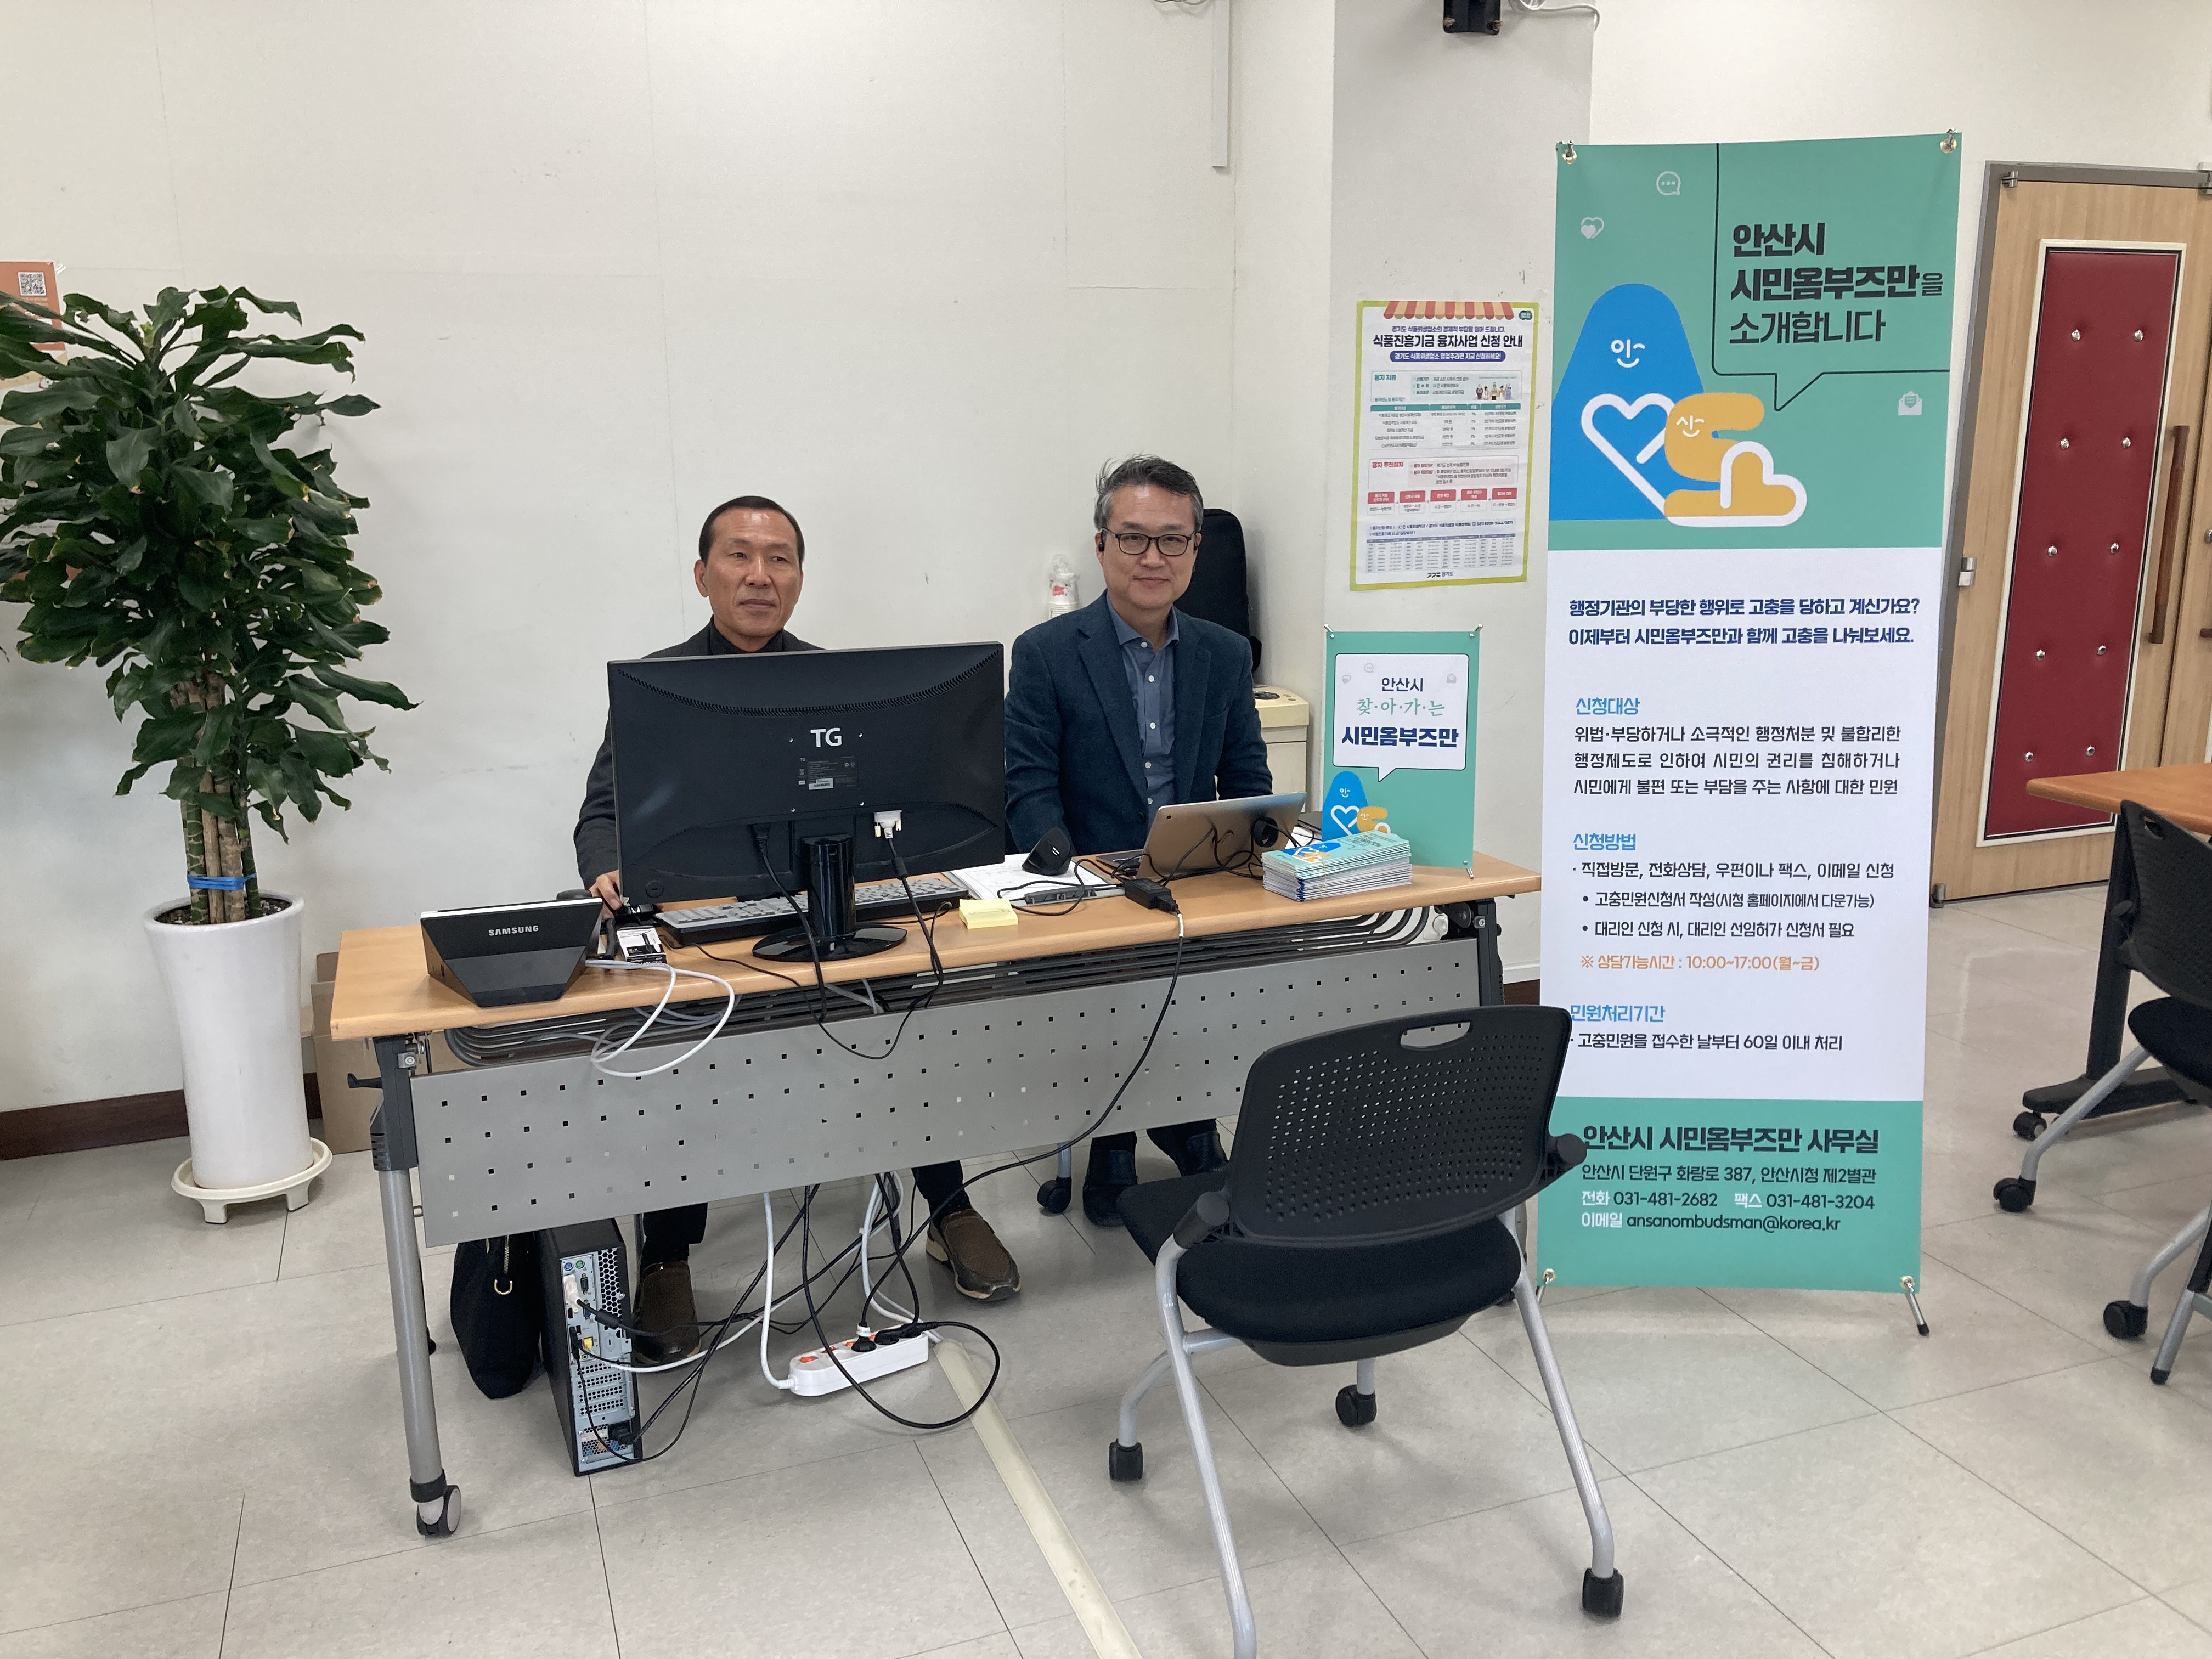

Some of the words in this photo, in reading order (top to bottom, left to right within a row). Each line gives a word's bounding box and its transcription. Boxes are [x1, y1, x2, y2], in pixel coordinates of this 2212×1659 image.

[1733, 223, 1825, 257] 안산시
[1730, 264, 1943, 301] 시민옴부즈만을
[1729, 311, 1886, 345] 소개합니다
[1373, 335, 1435, 347] 식품진흥기금
[1438, 335, 1477, 347] 융자사업
[1481, 335, 1500, 347] 신청
[1504, 335, 1523, 347] 안내
[1570, 599, 1645, 616] 행정기관의
[1649, 599, 1696, 616] 부당한
[1699, 599, 1745, 616] 행위로
[1748, 599, 1795, 616] 고충을
[1799, 598, 1845, 615] 당하고
[1849, 598, 1920, 615] 계신가요?
[1568, 628, 1630, 646] 이제부터
[1634, 627, 1742, 645] 시민옴부즈만과
[1747, 627, 1777, 644] 함께
[1781, 627, 1828, 644] 고충을
[1832, 627, 1914, 644] 나눠보세요.
[1381, 677, 1424, 692] 안산시
[1575, 698, 1640, 715] 신청대상
[810, 727, 842, 747] TG
[1342, 726, 1459, 748] 시민옴부즈만
[1574, 726, 1686, 743] 위법·부당하거나
[1690, 726, 1751, 743] 소극적인
[1756, 726, 1815, 743] 행정처분
[1821, 726, 1836, 743] 및
[1841, 726, 1901, 742] 불합리한
[1574, 752, 1653, 769] 행정제도로
[1659, 752, 1706, 769] 인하여
[1713, 752, 1759, 769] 시민의
[1767, 752, 1813, 769] 권리를
[1821, 752, 1900, 769] 침해하거나
[1574, 779, 1632, 795] 시민에게
[1636, 779, 1665, 795] 불편
[1671, 779, 1699, 795] 또는
[1703, 778, 1747, 795] 부담을
[1752, 779, 1781, 795] 주는
[1786, 779, 1830, 795] 사항에
[1835, 779, 1864, 795] 대한
[1869, 779, 1898, 795] 민원
[1572, 833, 1637, 851] 신청방법
[1581, 863, 1643, 880] 직접방문,
[1649, 862, 1710, 880] 전화상담,
[1716, 863, 1774, 879] 우편이나
[1779, 862, 1811, 881] 팩스,
[1817, 863, 1860, 879] 이메일
[1866, 863, 1894, 879] 신청
[1595, 892, 1686, 909] 고충민원신청서
[1689, 892, 1745, 909] 작성(시청
[1747, 893, 1819, 909] 홈페이지에서
[1821, 893, 1875, 909] 다운가능)
[488, 925, 539, 936] SAMSUNG
[1595, 922, 1634, 938] 대리인
[1638, 922, 1663, 938] 신청
[1667, 922, 1683, 939] 시,
[1688, 922, 1726, 938] 대리인
[1730, 922, 1782, 938] 선임허가
[1786, 922, 1825, 938] 신청서
[1829, 922, 1854, 938] 필요
[1598, 956, 1675, 971] 상담가능시간
[1686, 955, 1820, 972] 10:00~17:00(월~금)
[1570, 1006, 1665, 1023] 민원처리기간
[1578, 1034, 1647, 1049] 고충민원을
[1652, 1034, 1694, 1049] 접수한
[1697, 1035, 1739, 1051] 날부터
[1743, 1035, 1778, 1051] 60일
[1782, 1035, 1810, 1051] 이내
[1814, 1035, 1843, 1051] 처리
[1584, 1126, 1653, 1150] 안산시
[1660, 1127, 1802, 1153] 시민옴부즈만
[1807, 1129, 1879, 1153] 사무실
[1582, 1166, 1624, 1181] 안산시
[1629, 1166, 1672, 1181] 단원구
[1676, 1166, 1719, 1182] 화랑로
[1724, 1167, 1756, 1184] 387,
[1760, 1167, 1818, 1183] 안산시청
[1824, 1169, 1876, 1184] 제2별관
[1582, 1190, 1610, 1206] 전화
[1613, 1193, 1717, 1207] 031-481-2682
[1734, 1193, 1762, 1209] 팩스
[1766, 1194, 1875, 1209] 031-481-3204
[1581, 1212, 1623, 1228] 이메일
[1627, 1215, 1841, 1233] ansanombudsman@korea.kr
